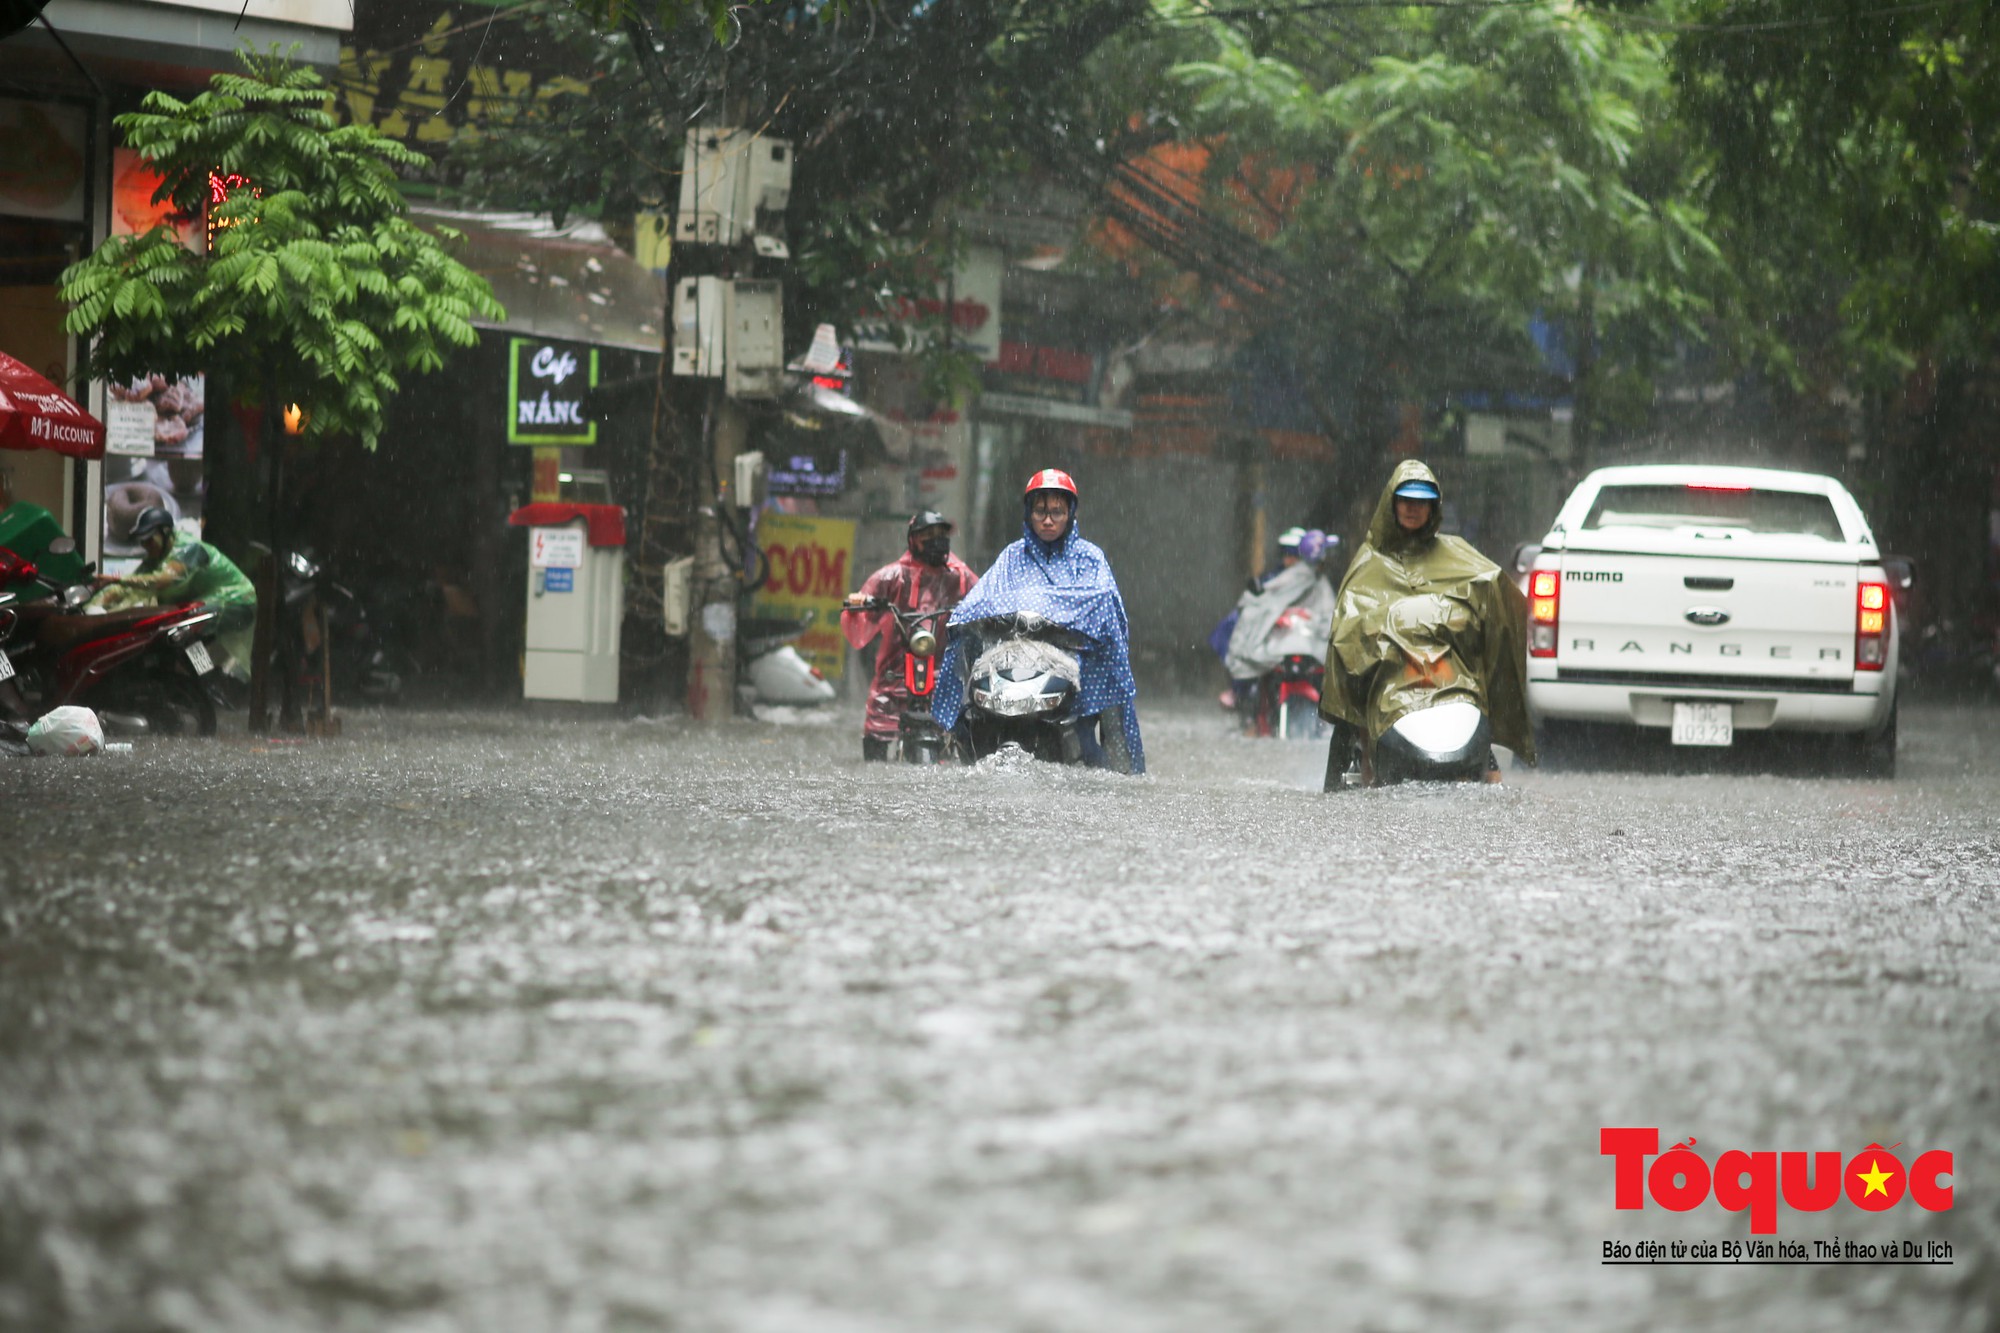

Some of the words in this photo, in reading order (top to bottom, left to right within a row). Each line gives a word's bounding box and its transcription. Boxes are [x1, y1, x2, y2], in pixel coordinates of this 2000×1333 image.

[53, 425, 95, 445] ACCOUNT
[766, 539, 847, 600] CƠM
[1572, 638, 1841, 661] RANGER
